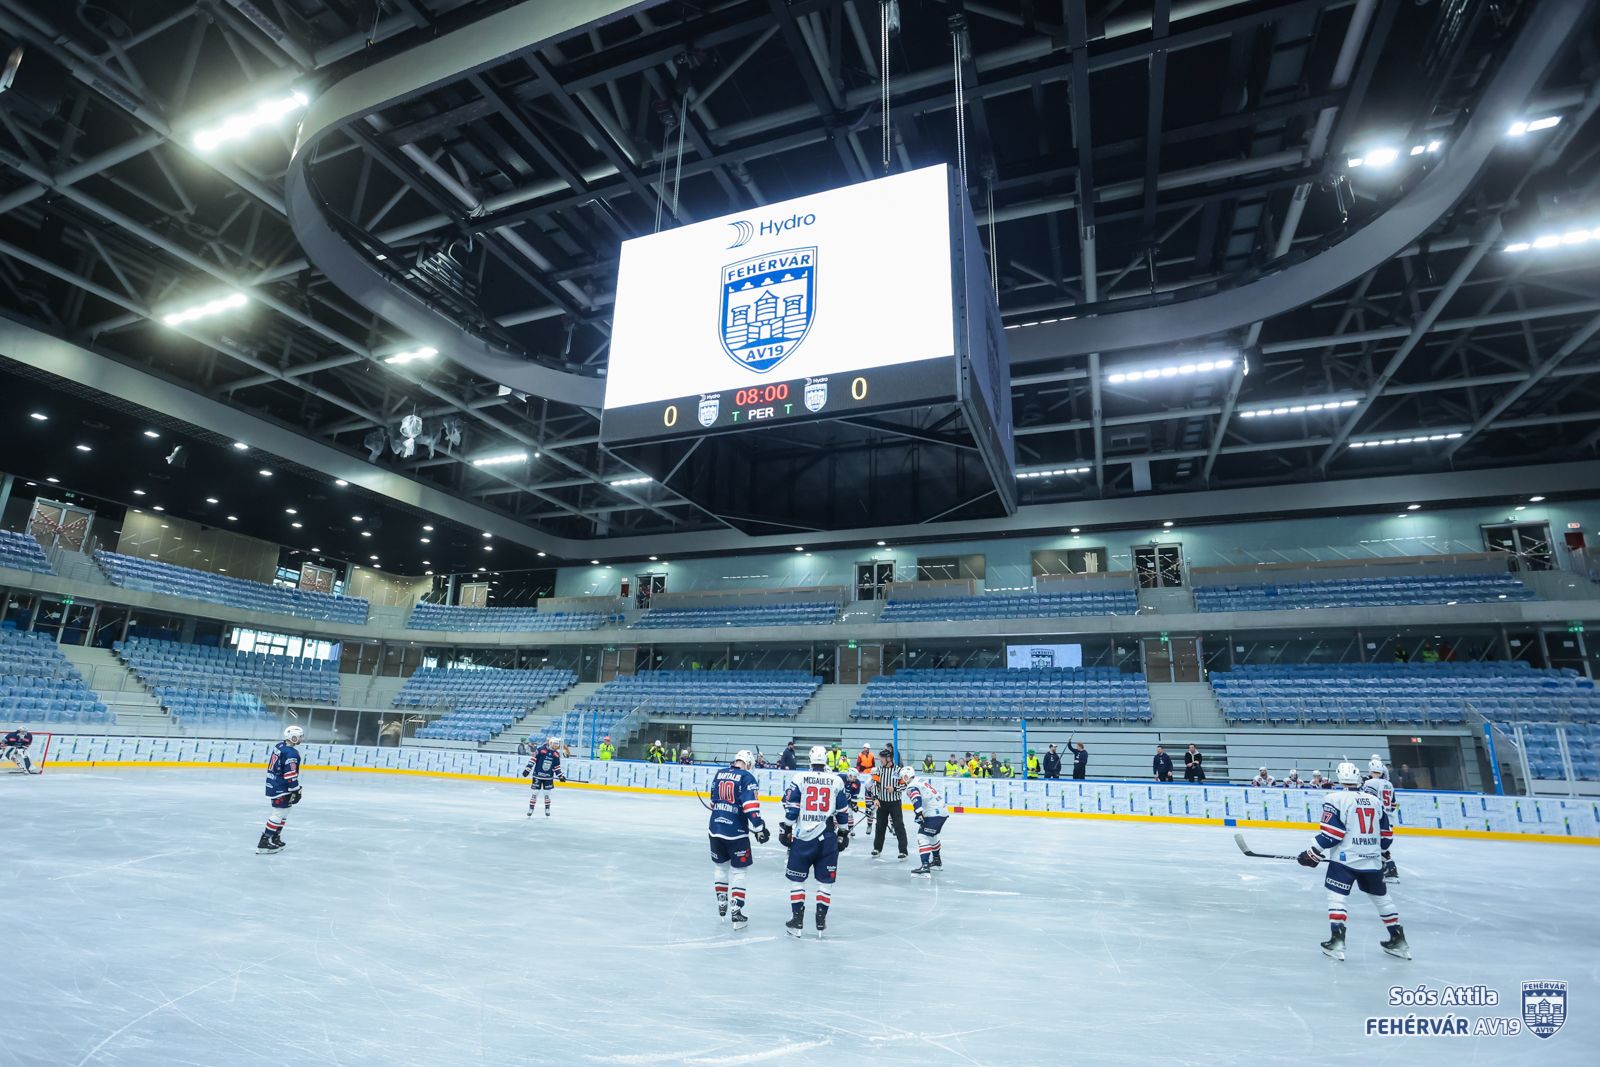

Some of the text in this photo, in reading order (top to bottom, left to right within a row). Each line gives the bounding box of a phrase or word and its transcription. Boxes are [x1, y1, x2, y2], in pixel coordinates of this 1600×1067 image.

[760, 214, 816, 236] Hydro
[728, 253, 811, 281] FEHÉRVÁR
[746, 345, 784, 361] AV19
[735, 383, 789, 406] 08:00
[852, 377, 867, 400] 0
[663, 405, 678, 427] 0
[732, 403, 793, 422] T PER T
[803, 776, 834, 785] MCGAULEY
[718, 781, 735, 804] 10
[806, 786, 830, 812] 23
[1355, 807, 1375, 834] 17
